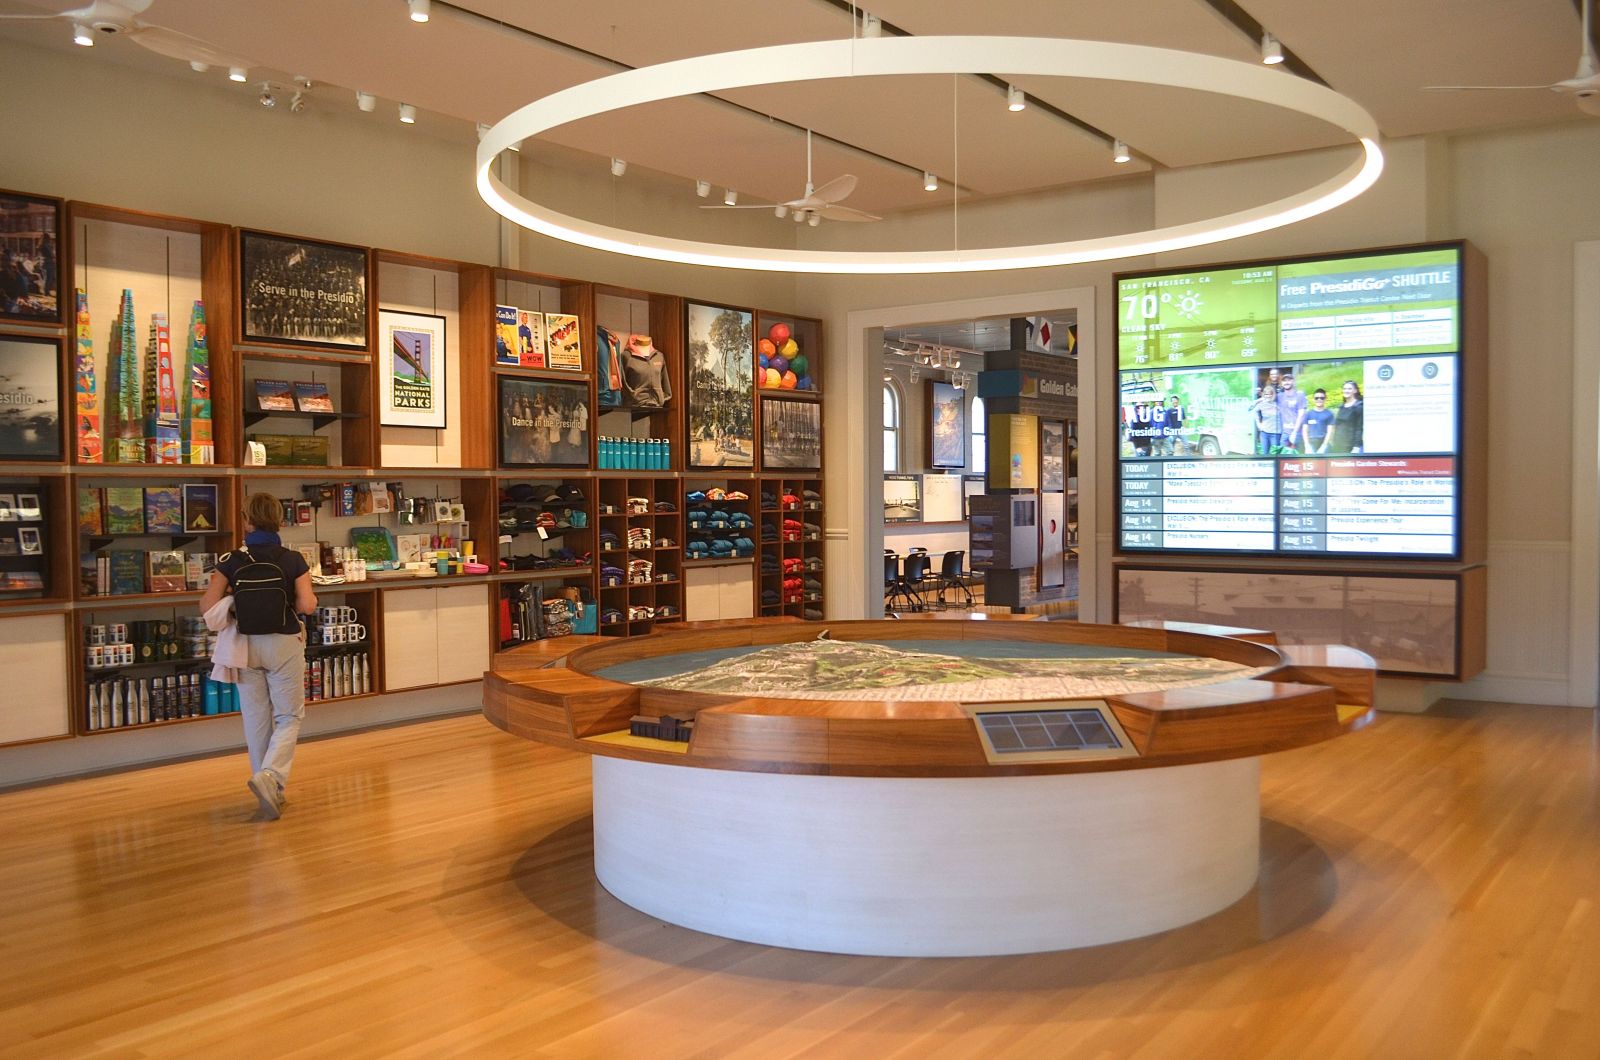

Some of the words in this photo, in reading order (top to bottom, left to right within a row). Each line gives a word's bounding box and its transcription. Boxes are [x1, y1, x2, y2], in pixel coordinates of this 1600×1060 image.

[1280, 284, 1306, 296] Free
[1392, 271, 1452, 288] SHUTTLE
[259, 282, 286, 295] Serve
[288, 288, 298, 296] in
[300, 288, 315, 299] the
[318, 290, 354, 304] Presidio
[1040, 379, 1064, 396] Golden
[395, 398, 430, 407] PARKS
[1124, 405, 1164, 422] AUG
[1176, 404, 1199, 421] 15
[512, 417, 534, 426] Dance
[534, 418, 542, 426] in
[544, 418, 554, 427] the
[556, 419, 582, 428] Presidio
[1126, 428, 1162, 436] Presidio
[1125, 464, 1149, 472] TODAY
[1284, 462, 1300, 472] Aug
[1302, 462, 1314, 470] 15
[1125, 481, 1149, 490] TODAY
[1283, 481, 1300, 490] Aug
[1125, 499, 1139, 508] Aug
[1283, 499, 1300, 509] Aug
[1302, 499, 1313, 507] 15
[1125, 516, 1139, 525] Aug
[1283, 517, 1300, 527] Aug
[1302, 517, 1313, 526] 15
[1125, 533, 1139, 542] Aug
[1283, 536, 1300, 545] Aug
[1302, 536, 1313, 544] 15
